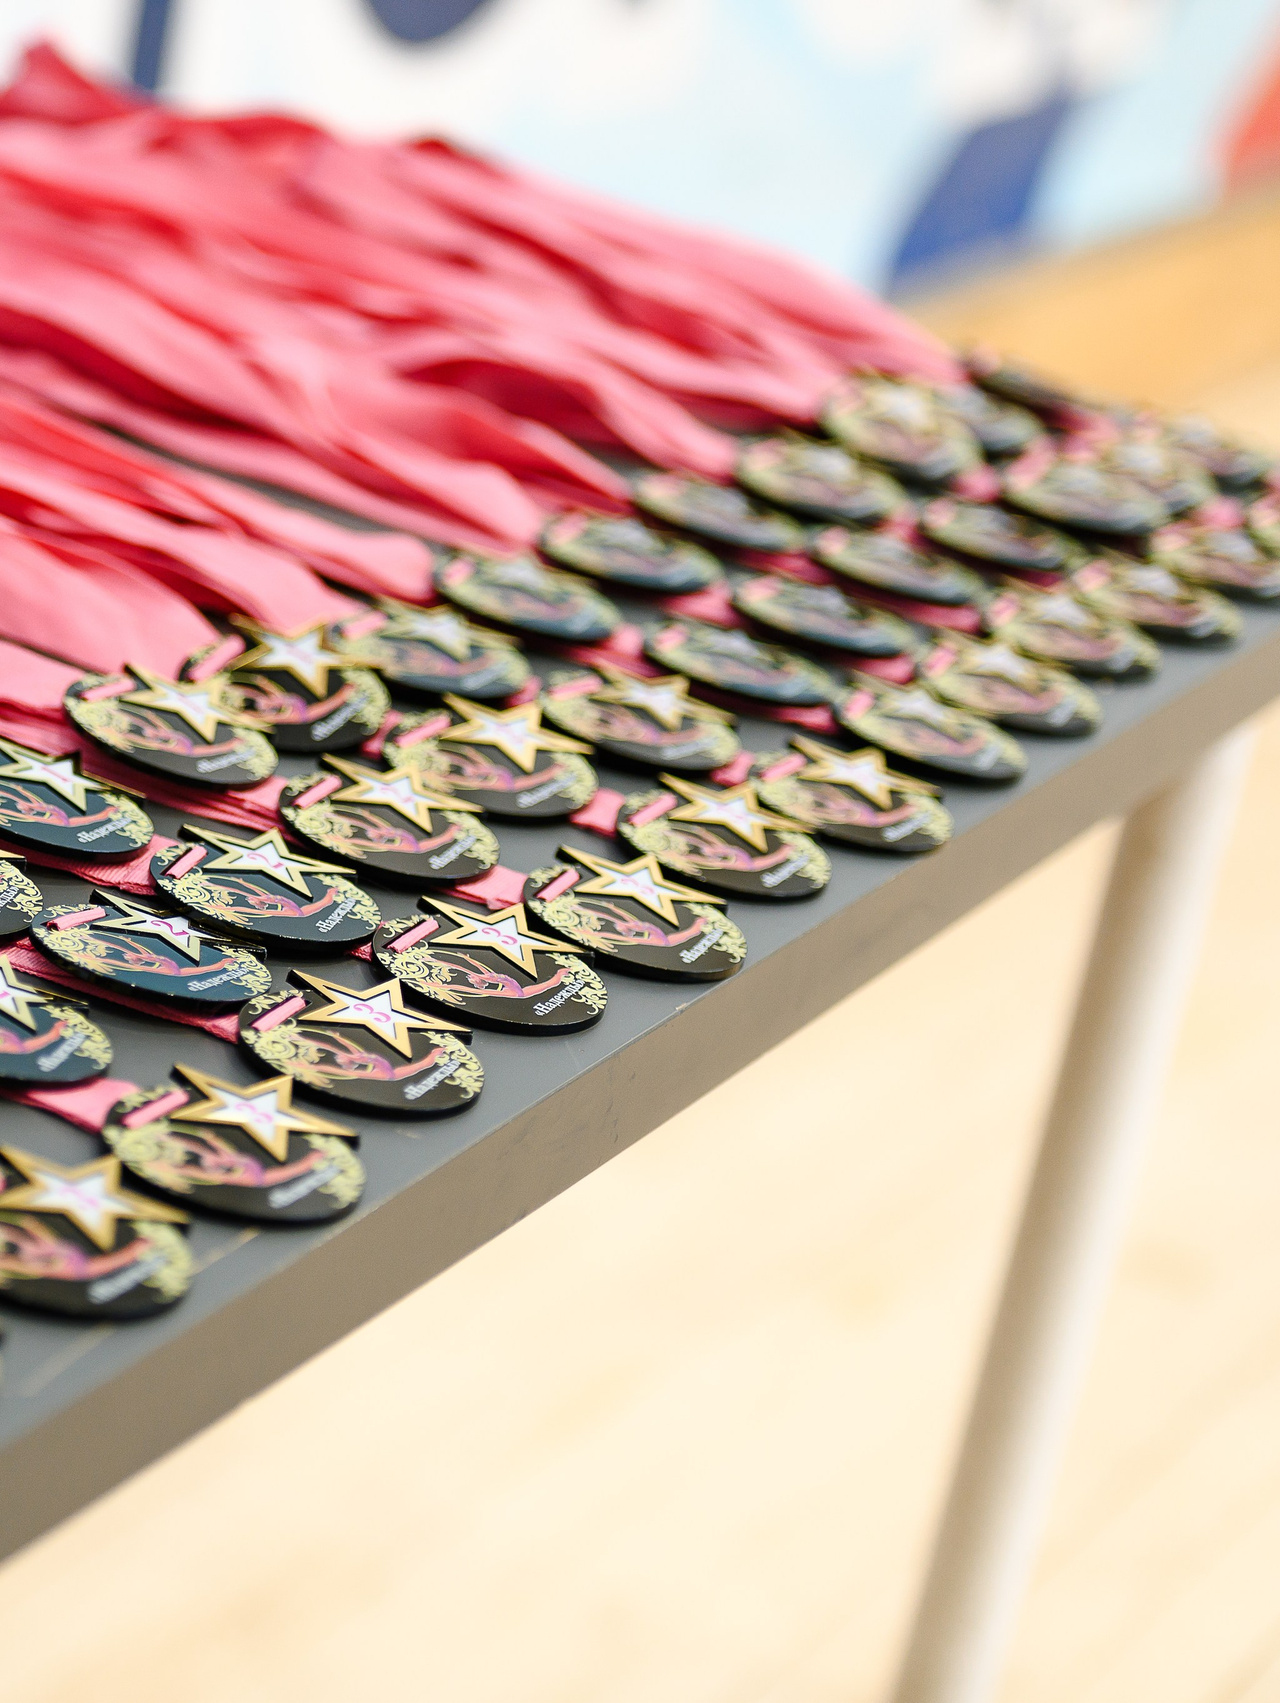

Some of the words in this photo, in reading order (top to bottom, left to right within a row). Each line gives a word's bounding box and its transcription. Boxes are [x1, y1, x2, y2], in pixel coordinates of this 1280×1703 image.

[246, 852, 285, 870] 2
[150, 919, 190, 937] 2
[480, 927, 519, 946] 3
[352, 1002, 392, 1024] 3
